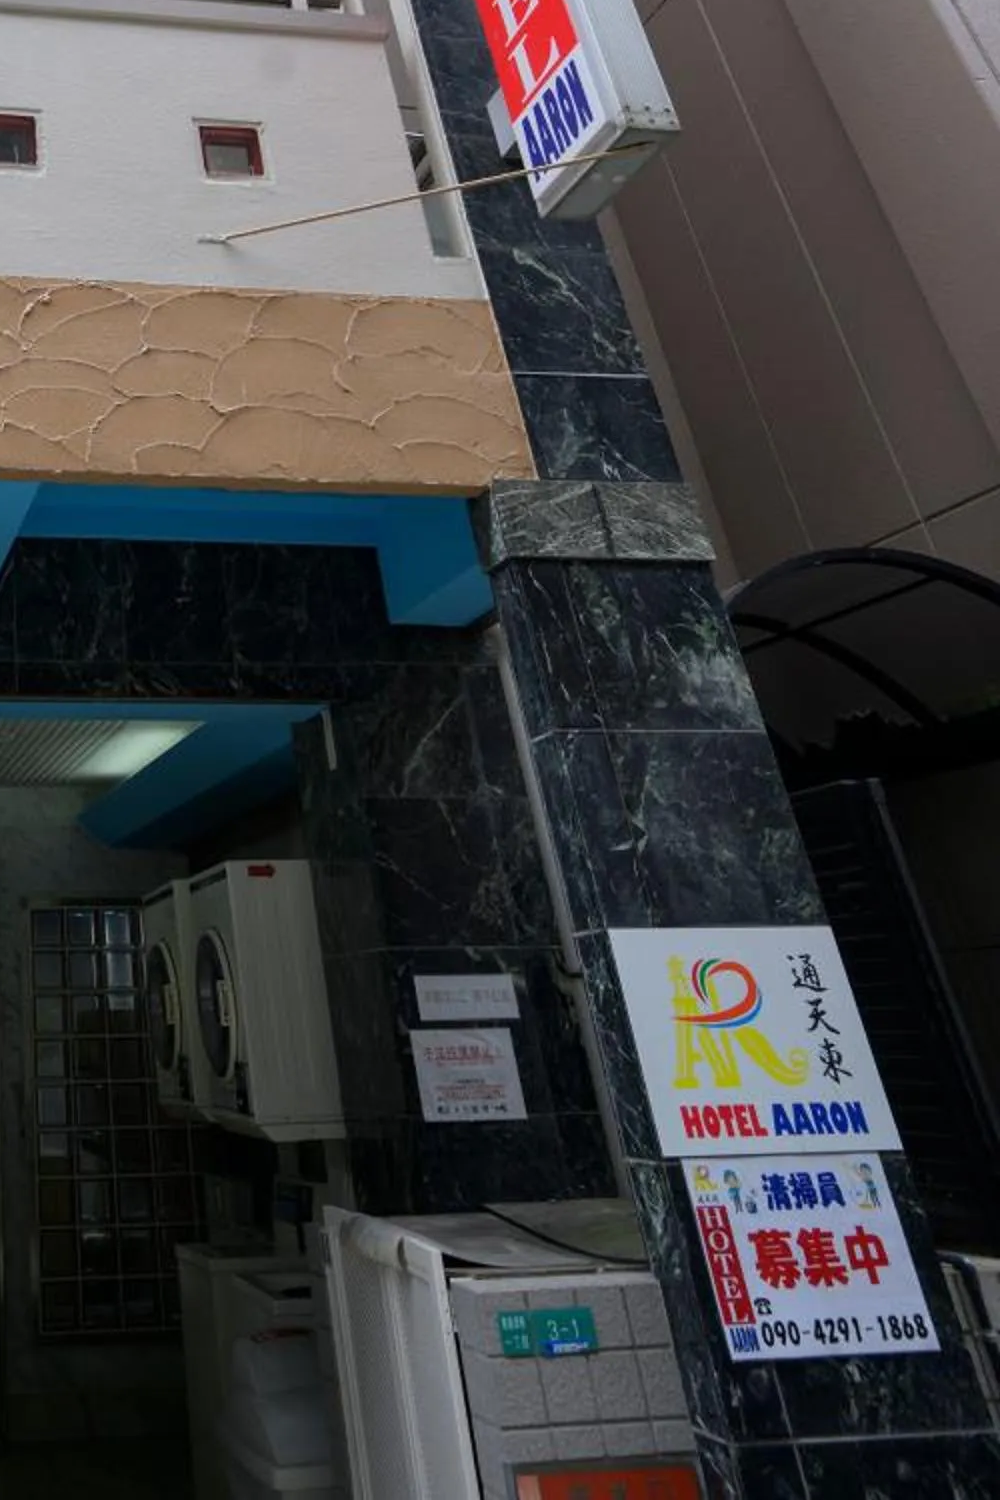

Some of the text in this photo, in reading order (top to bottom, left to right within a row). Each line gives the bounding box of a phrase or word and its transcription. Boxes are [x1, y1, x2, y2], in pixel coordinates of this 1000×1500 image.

[521, 59, 594, 181] AARON
[786, 953, 852, 1084] 通天東
[680, 1101, 869, 1139] HOTEL AARON
[761, 1171, 847, 1211] 清掃員
[703, 1207, 749, 1323] HOTEL
[748, 1225, 890, 1290] 募集中
[761, 1313, 929, 1348] 090-4291-1868
